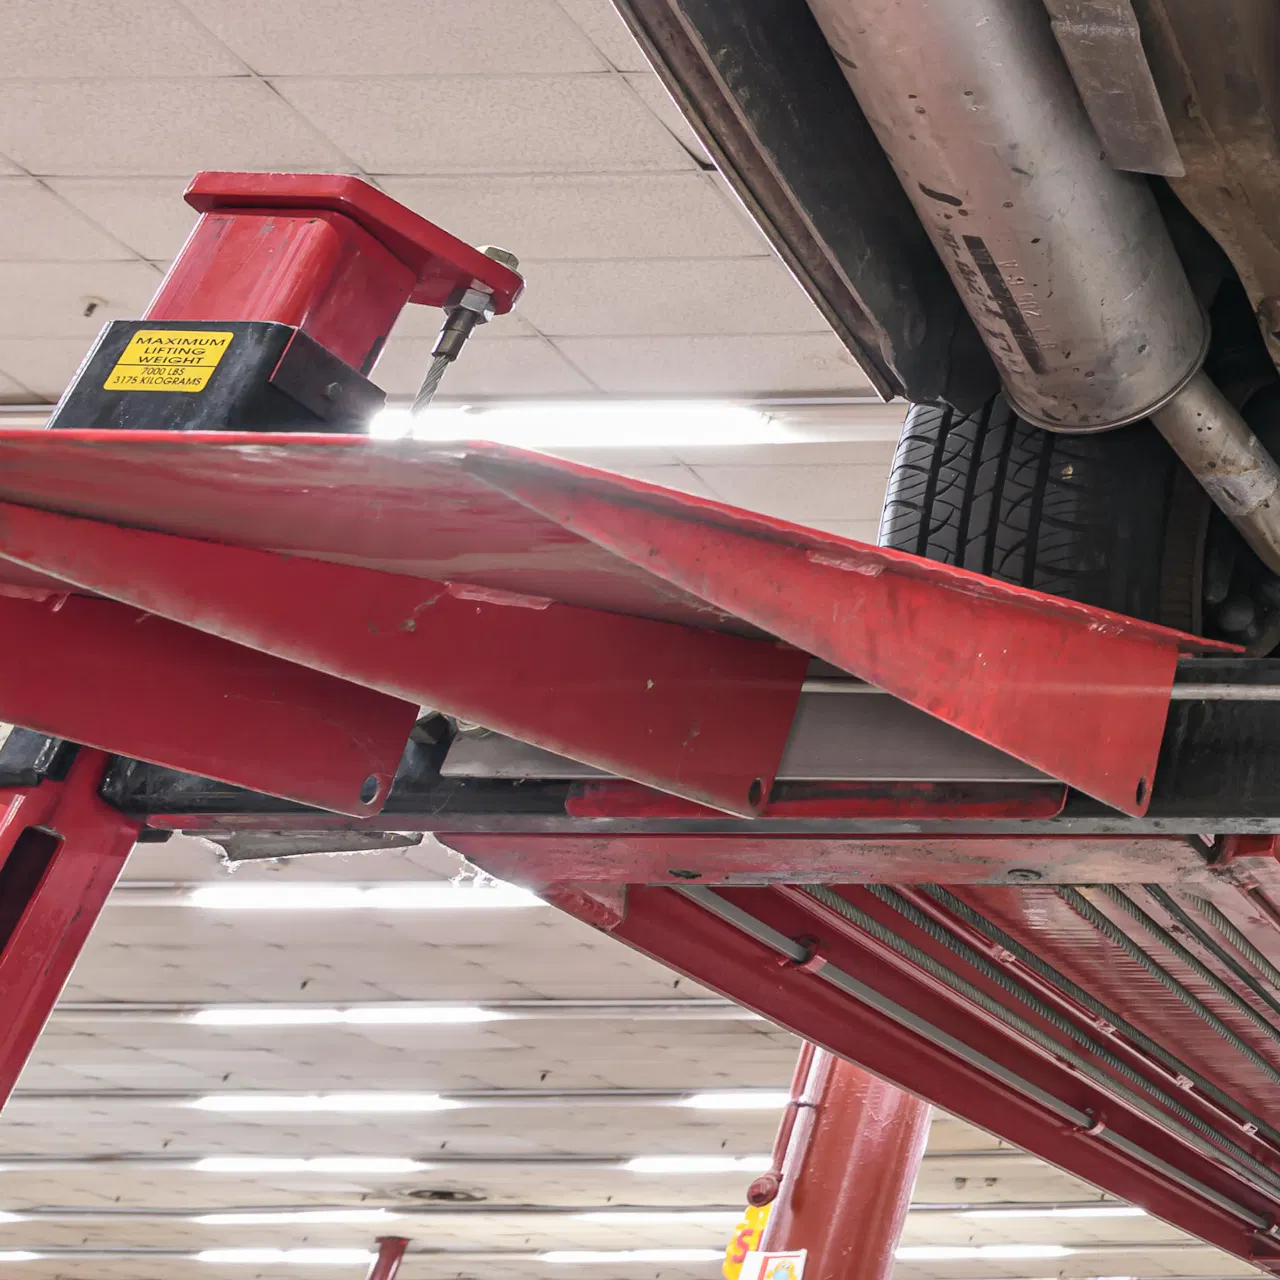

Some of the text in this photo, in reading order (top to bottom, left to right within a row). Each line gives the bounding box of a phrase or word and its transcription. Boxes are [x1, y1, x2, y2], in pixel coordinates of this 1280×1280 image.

[136, 337, 226, 346] MAXIMUM
[144, 347, 206, 356] LIFTING
[139, 356, 204, 365] WEIGHT
[141, 367, 185, 376] 7000 LBS
[113, 376, 202, 386] 3175 KILOGRAMS
